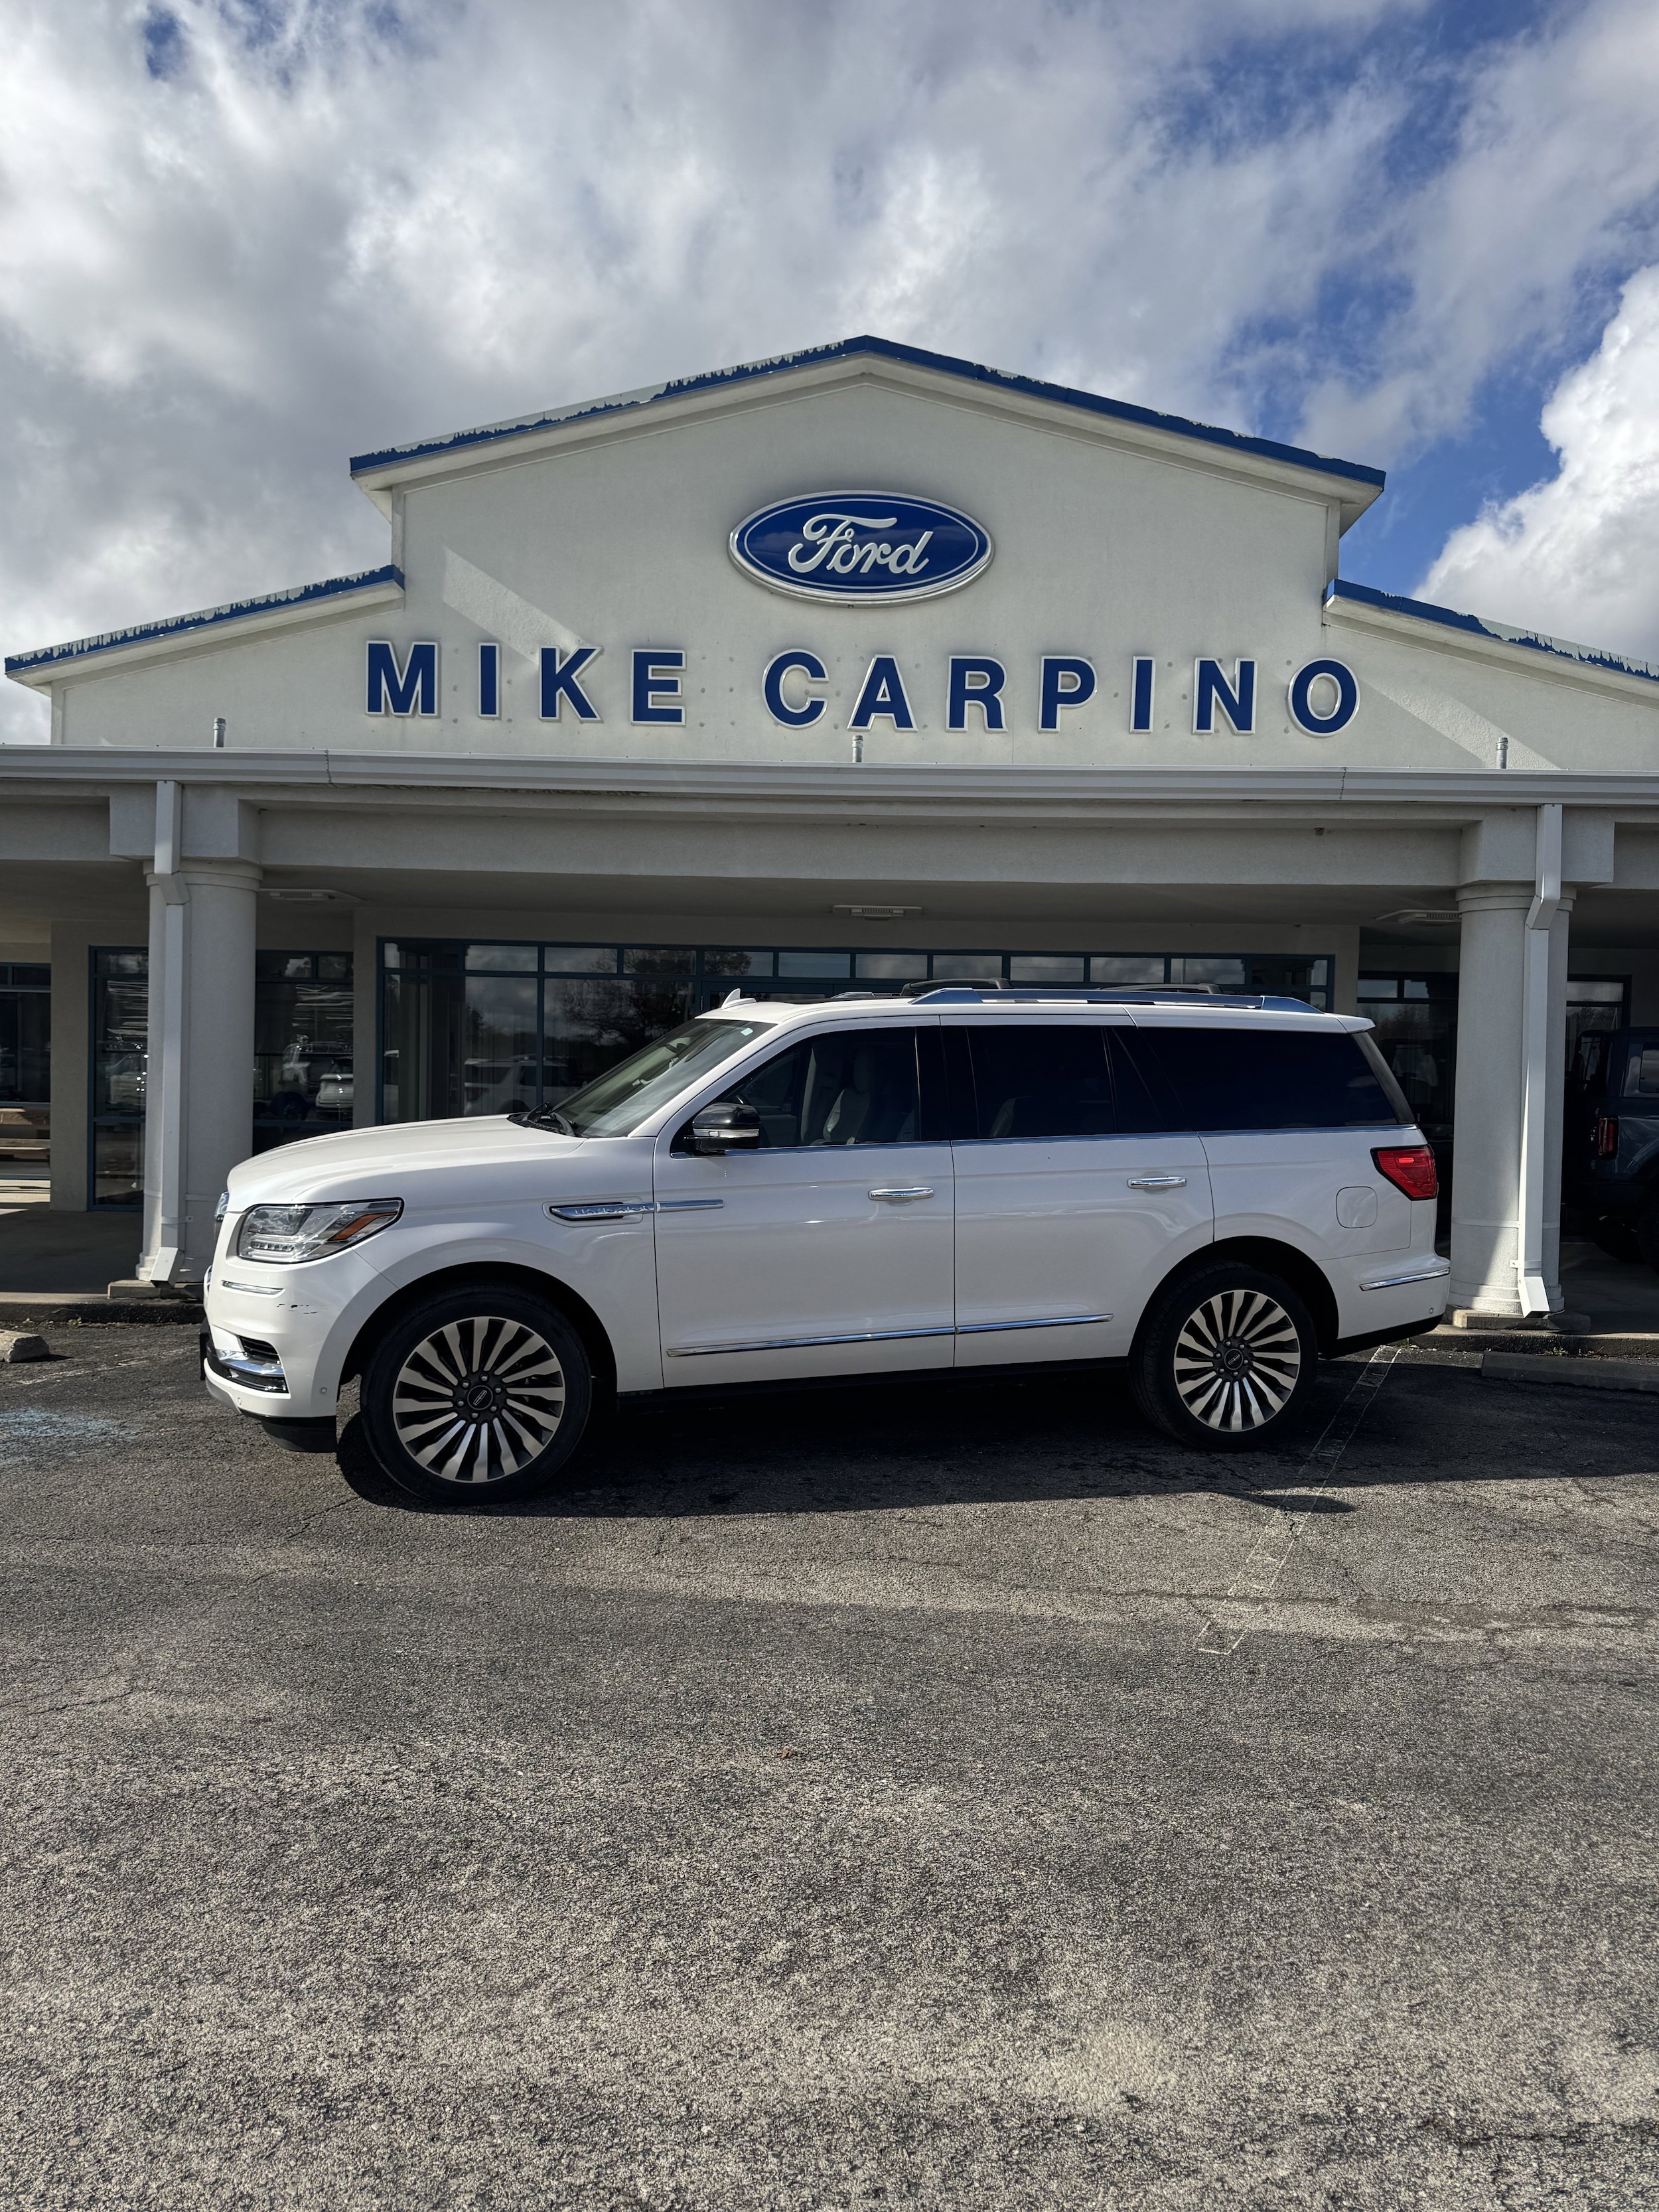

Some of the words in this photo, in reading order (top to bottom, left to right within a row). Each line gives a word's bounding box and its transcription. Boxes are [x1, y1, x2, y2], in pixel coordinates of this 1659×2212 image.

[788, 514, 934, 575] Ford
[365, 640, 687, 727] MIKE
[761, 648, 1360, 738] CARPINO
